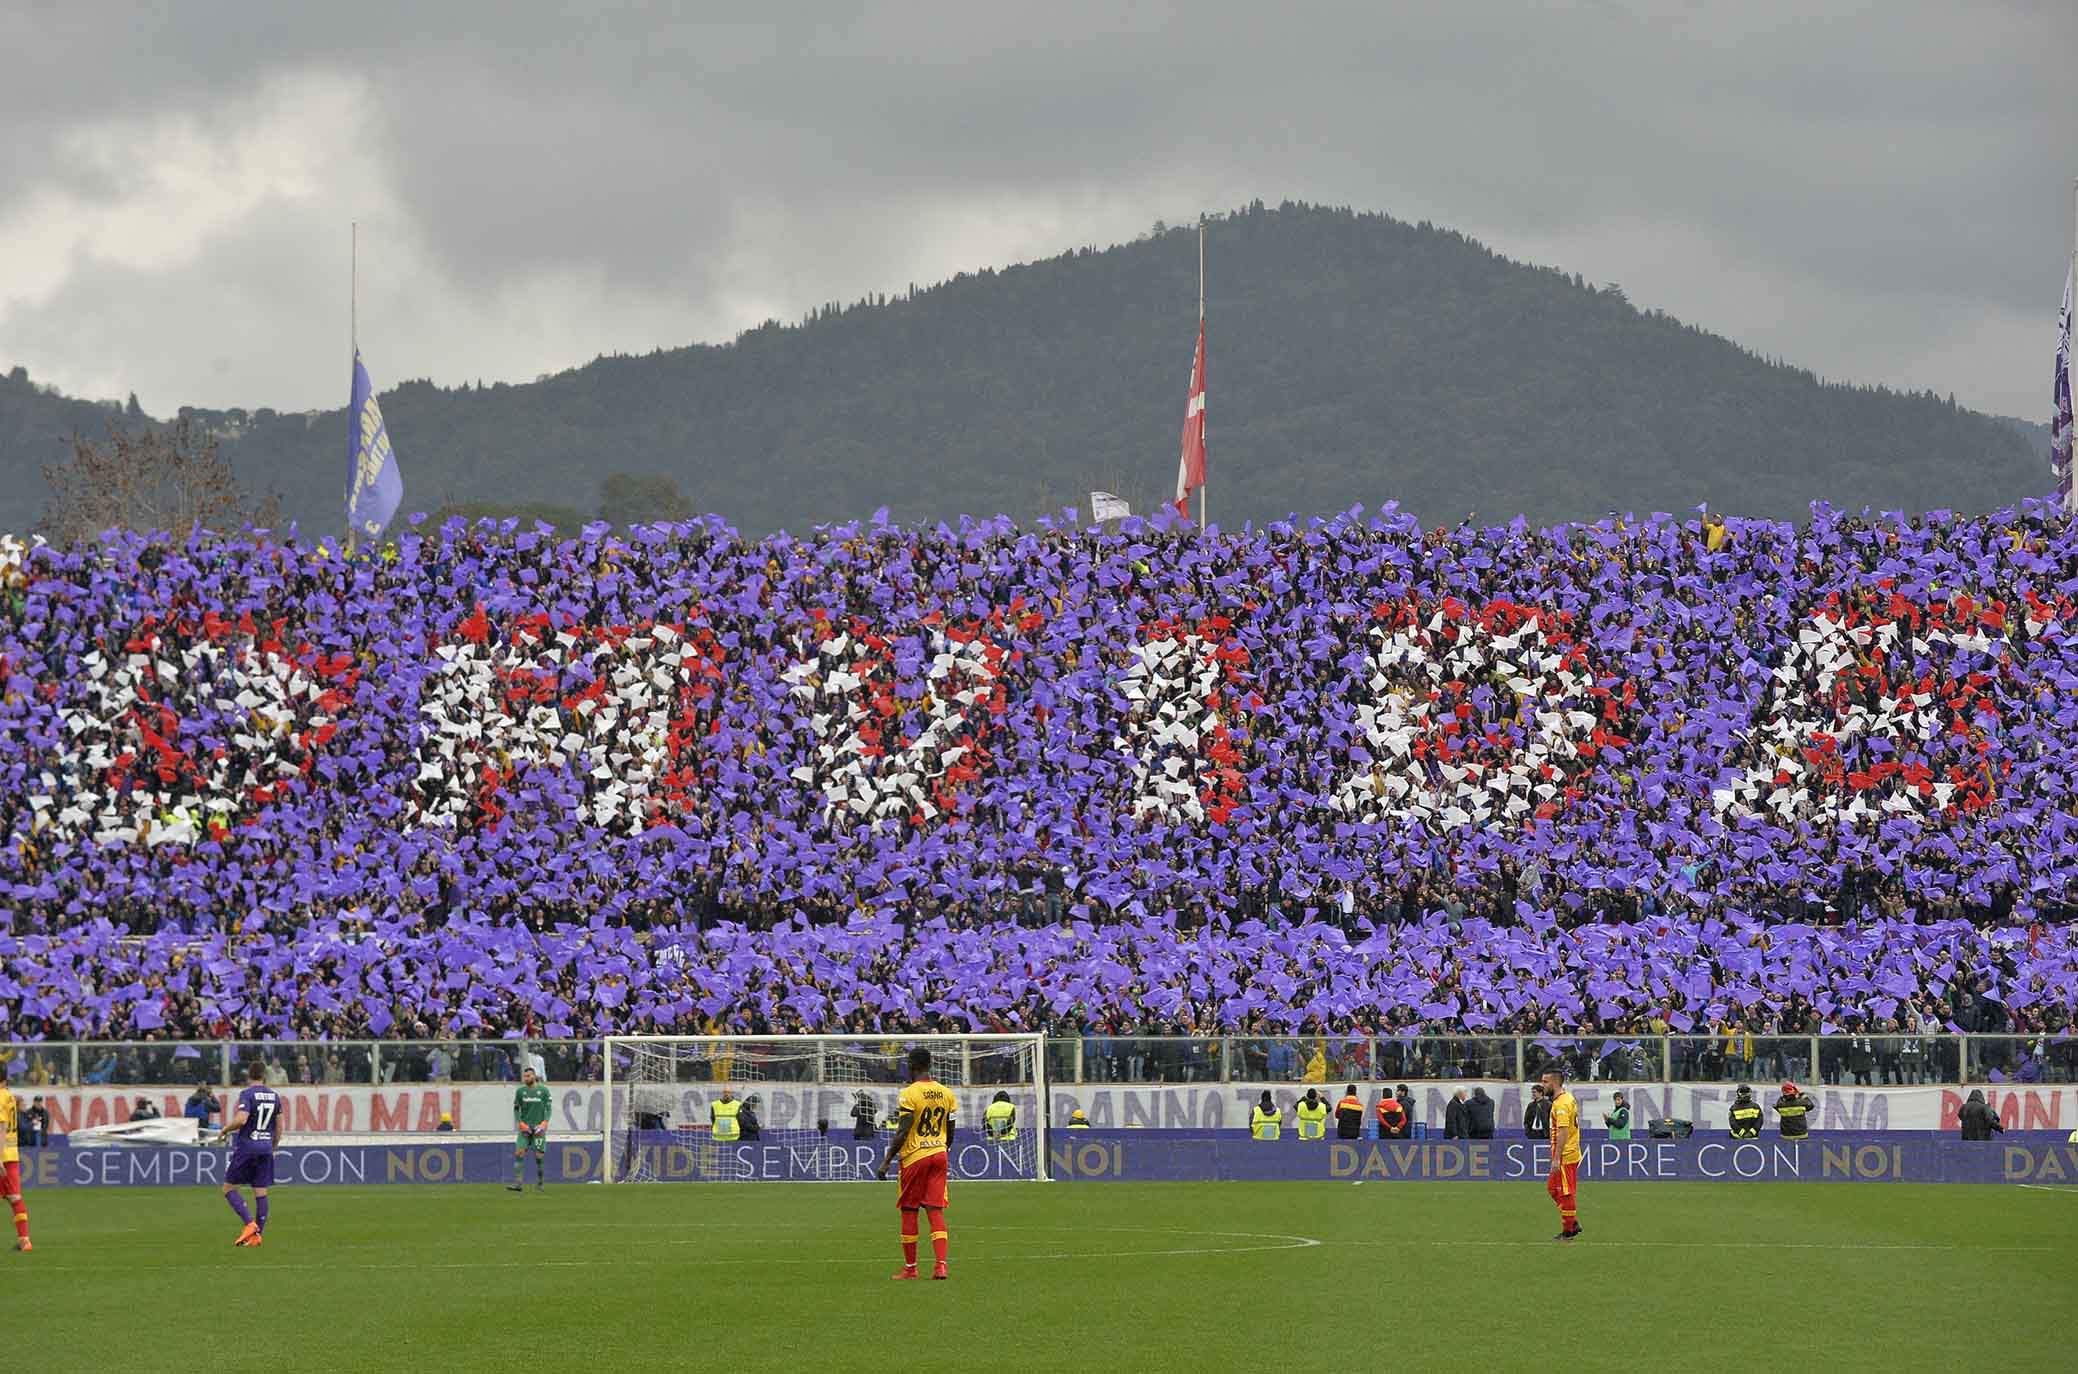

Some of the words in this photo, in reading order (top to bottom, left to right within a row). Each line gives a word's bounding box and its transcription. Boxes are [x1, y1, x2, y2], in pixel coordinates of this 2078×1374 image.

[257, 1102, 275, 1131] 17
[370, 1089, 461, 1132] MAI
[386, 1148, 465, 1182] NOI
[958, 1144, 1023, 1177] ON
[1051, 1142, 1122, 1177] NOI
[1329, 1143, 1490, 1177] DAVIDE
[1697, 1143, 1800, 1177] CON
[1823, 1144, 1903, 1178] NOI
